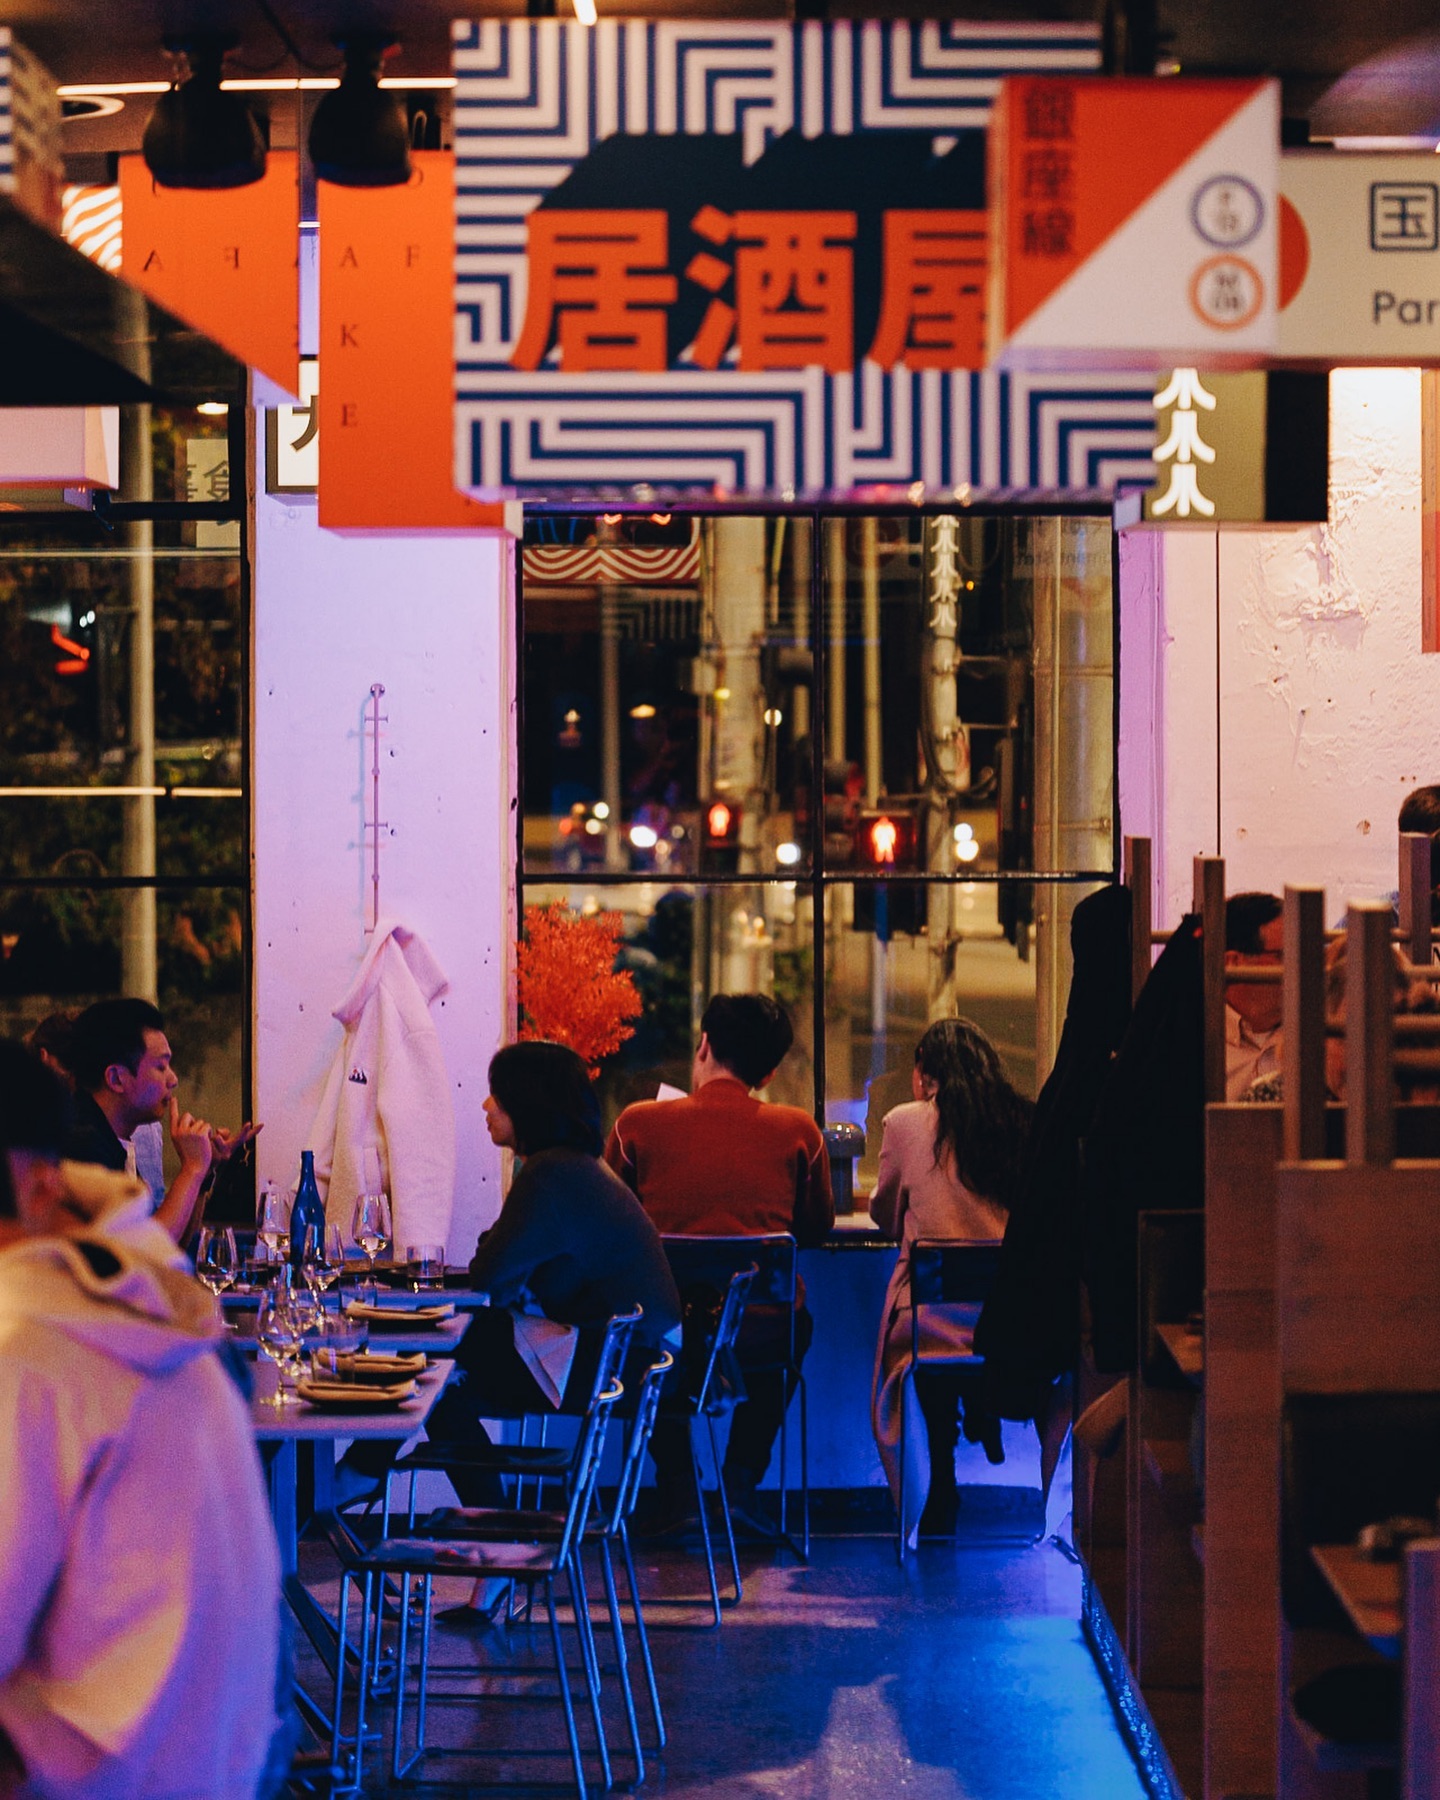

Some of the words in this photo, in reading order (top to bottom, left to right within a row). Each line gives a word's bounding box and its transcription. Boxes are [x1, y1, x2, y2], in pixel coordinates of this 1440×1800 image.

[340, 245, 359, 428] AKE
[508, 205, 988, 374] 居酒屋
